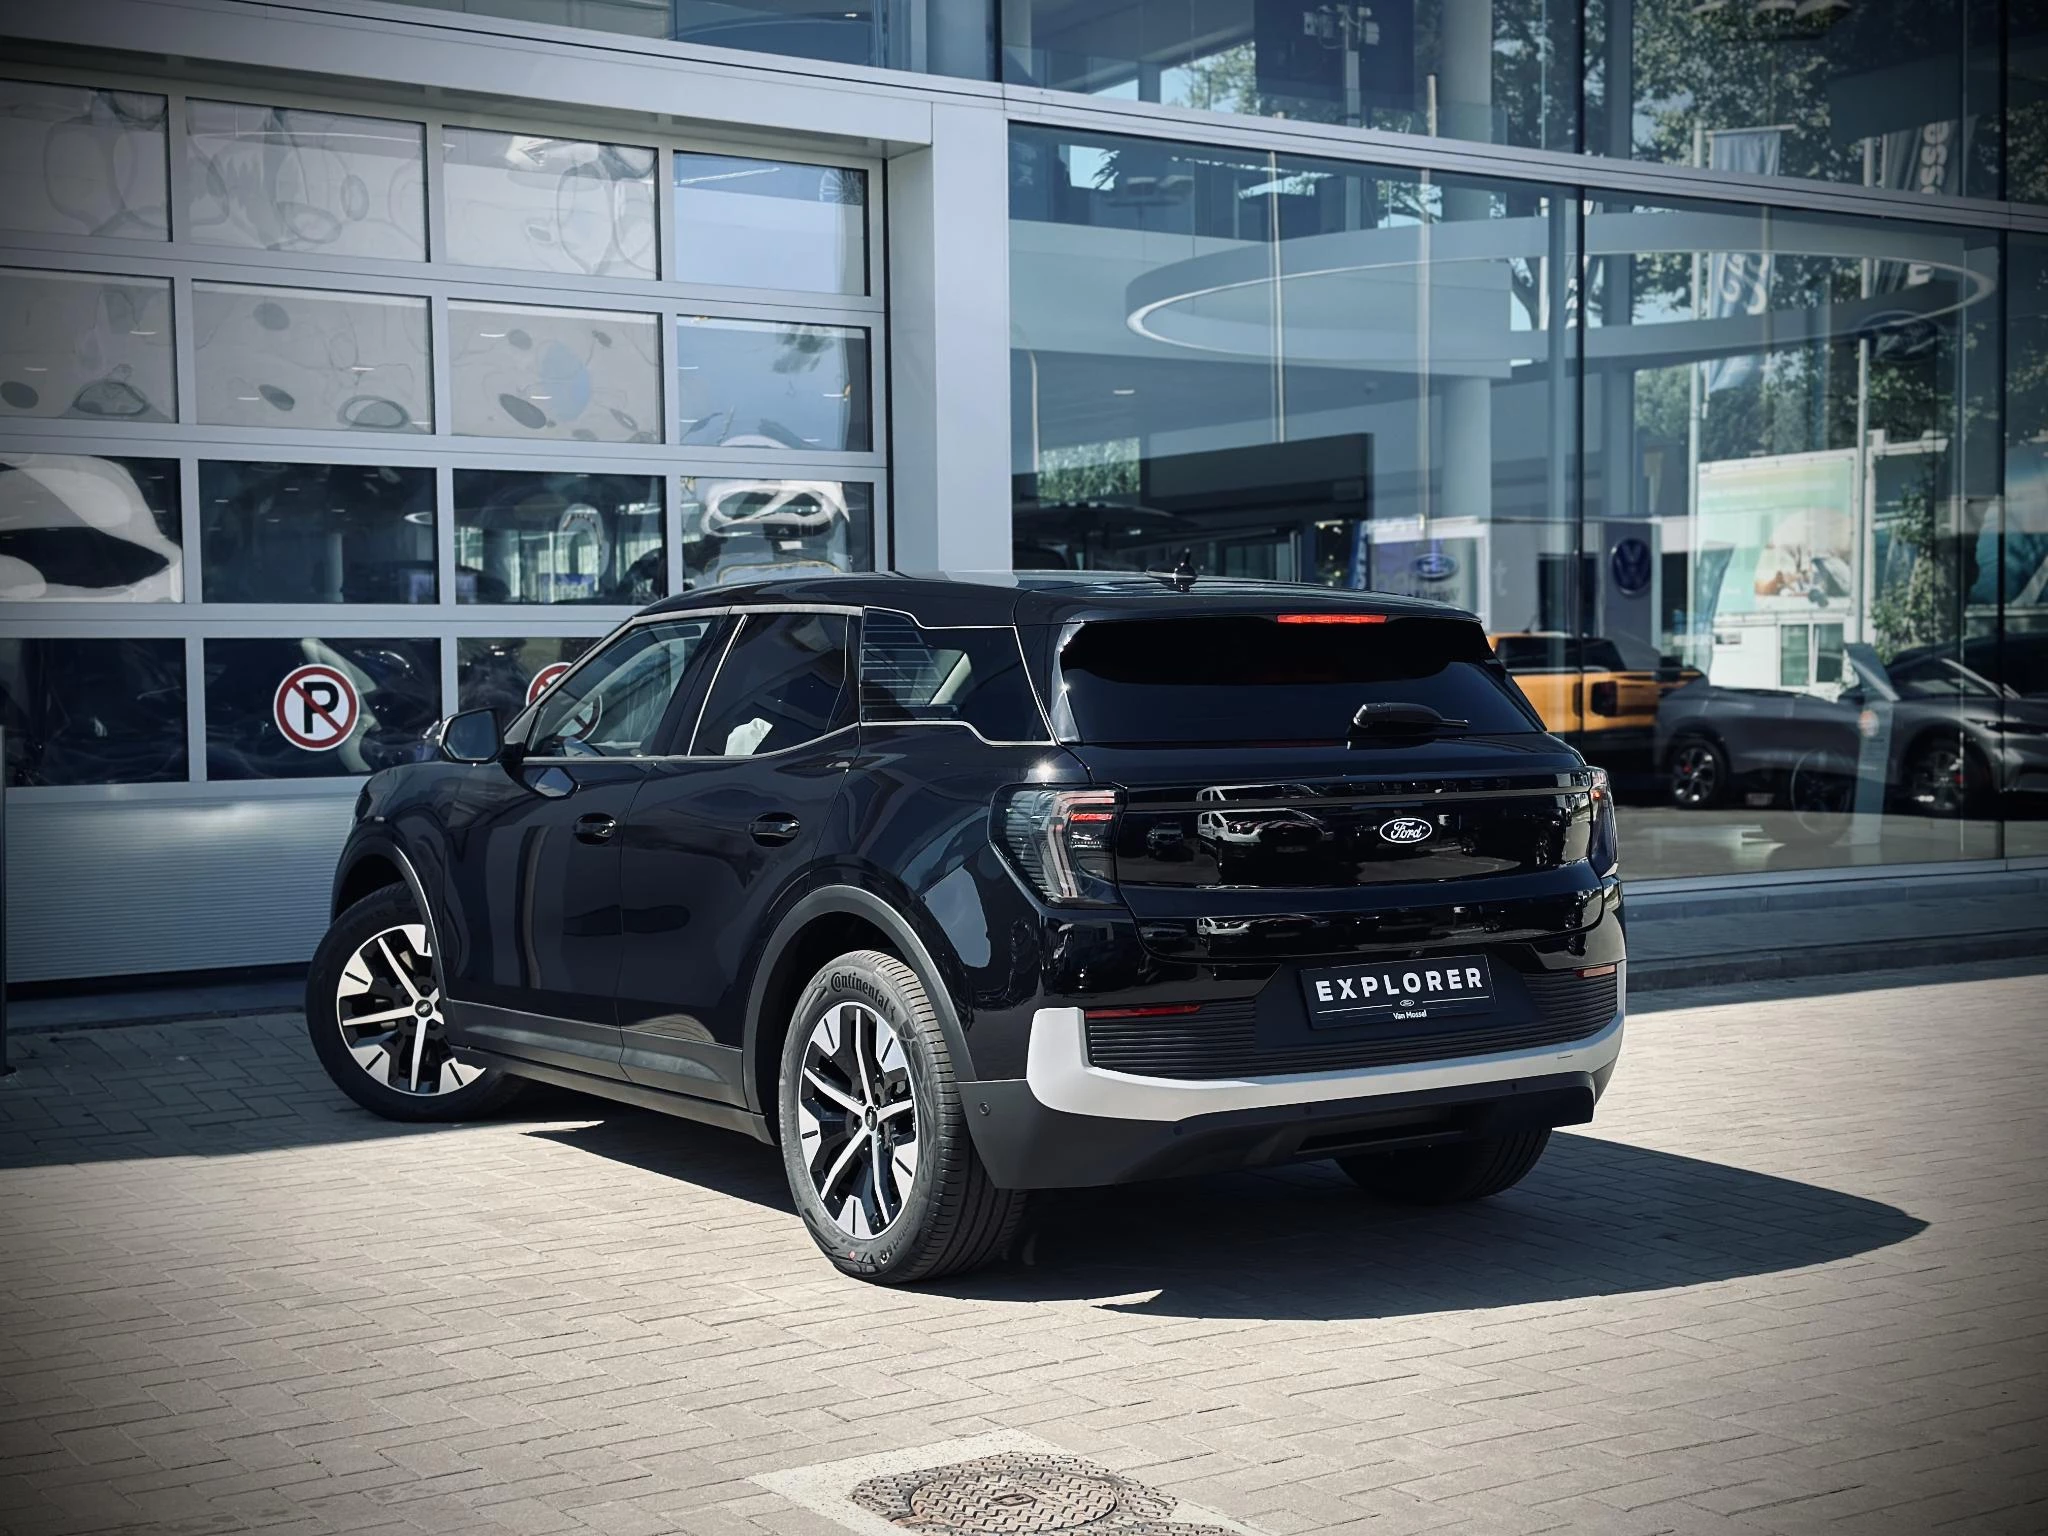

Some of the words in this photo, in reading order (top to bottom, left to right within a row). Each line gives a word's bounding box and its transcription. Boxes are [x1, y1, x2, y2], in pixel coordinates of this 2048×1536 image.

[302, 681, 339, 734] P
[1389, 820, 1425, 841] Ford
[830, 971, 890, 1013] Continental
[1315, 967, 1483, 1002] EXPLORER
[1392, 1012, 1405, 1020] Van
[1405, 1009, 1427, 1019] Mossel
